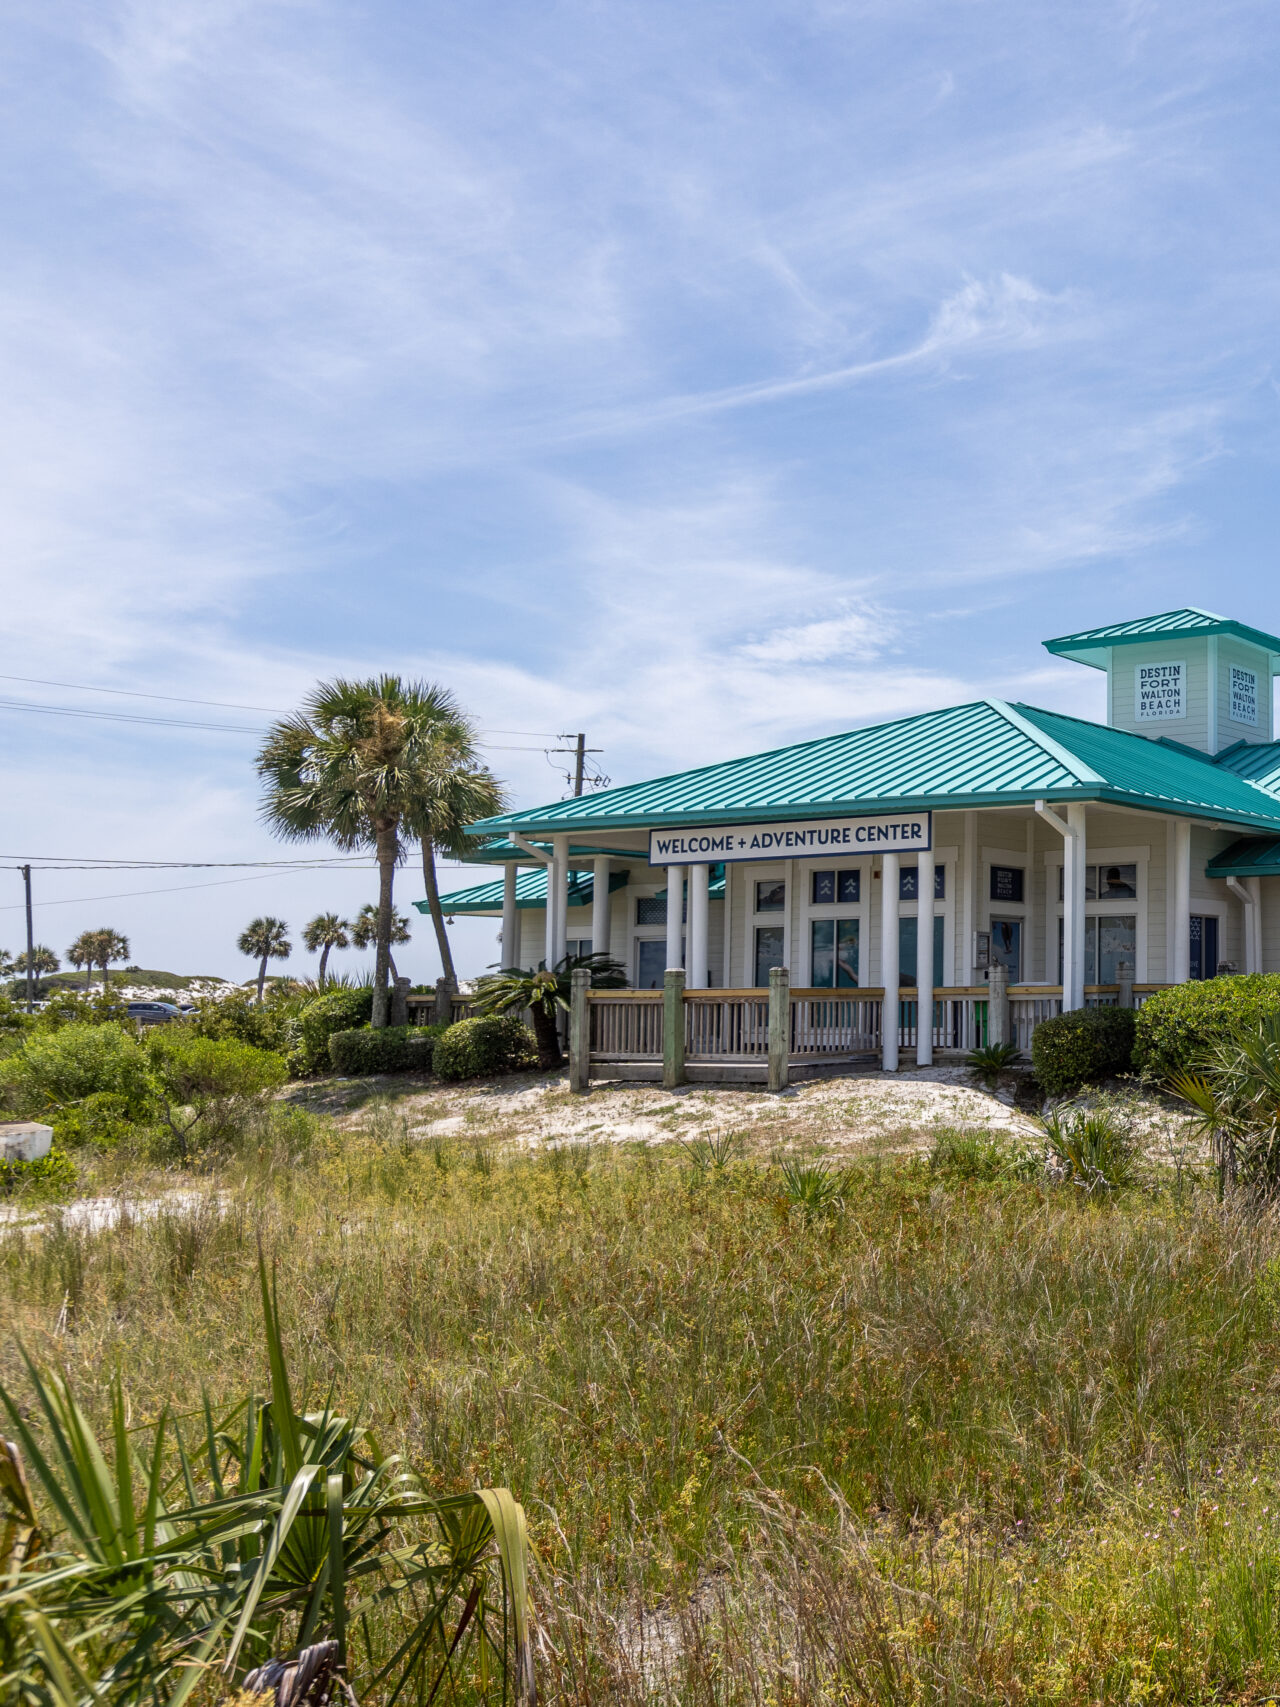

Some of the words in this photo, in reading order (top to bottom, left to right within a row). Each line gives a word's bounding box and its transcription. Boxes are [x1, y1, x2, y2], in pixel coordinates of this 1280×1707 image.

[1140, 666, 1181, 679] DESTIN
[1232, 668, 1255, 685] DESTIN
[1140, 678, 1180, 689] FORT
[1232, 680, 1255, 694] FORT
[1141, 688, 1180, 700] WALTON
[1233, 691, 1255, 705] WALTON
[1141, 699, 1180, 710] BEACH
[1232, 701, 1255, 715] BEACH
[1140, 709, 1180, 717] FLORIDA
[656, 835, 734, 855] WELCOME
[737, 837, 747, 849] +
[750, 827, 851, 850] ADVENTURE
[855, 822, 922, 843] CENTER
